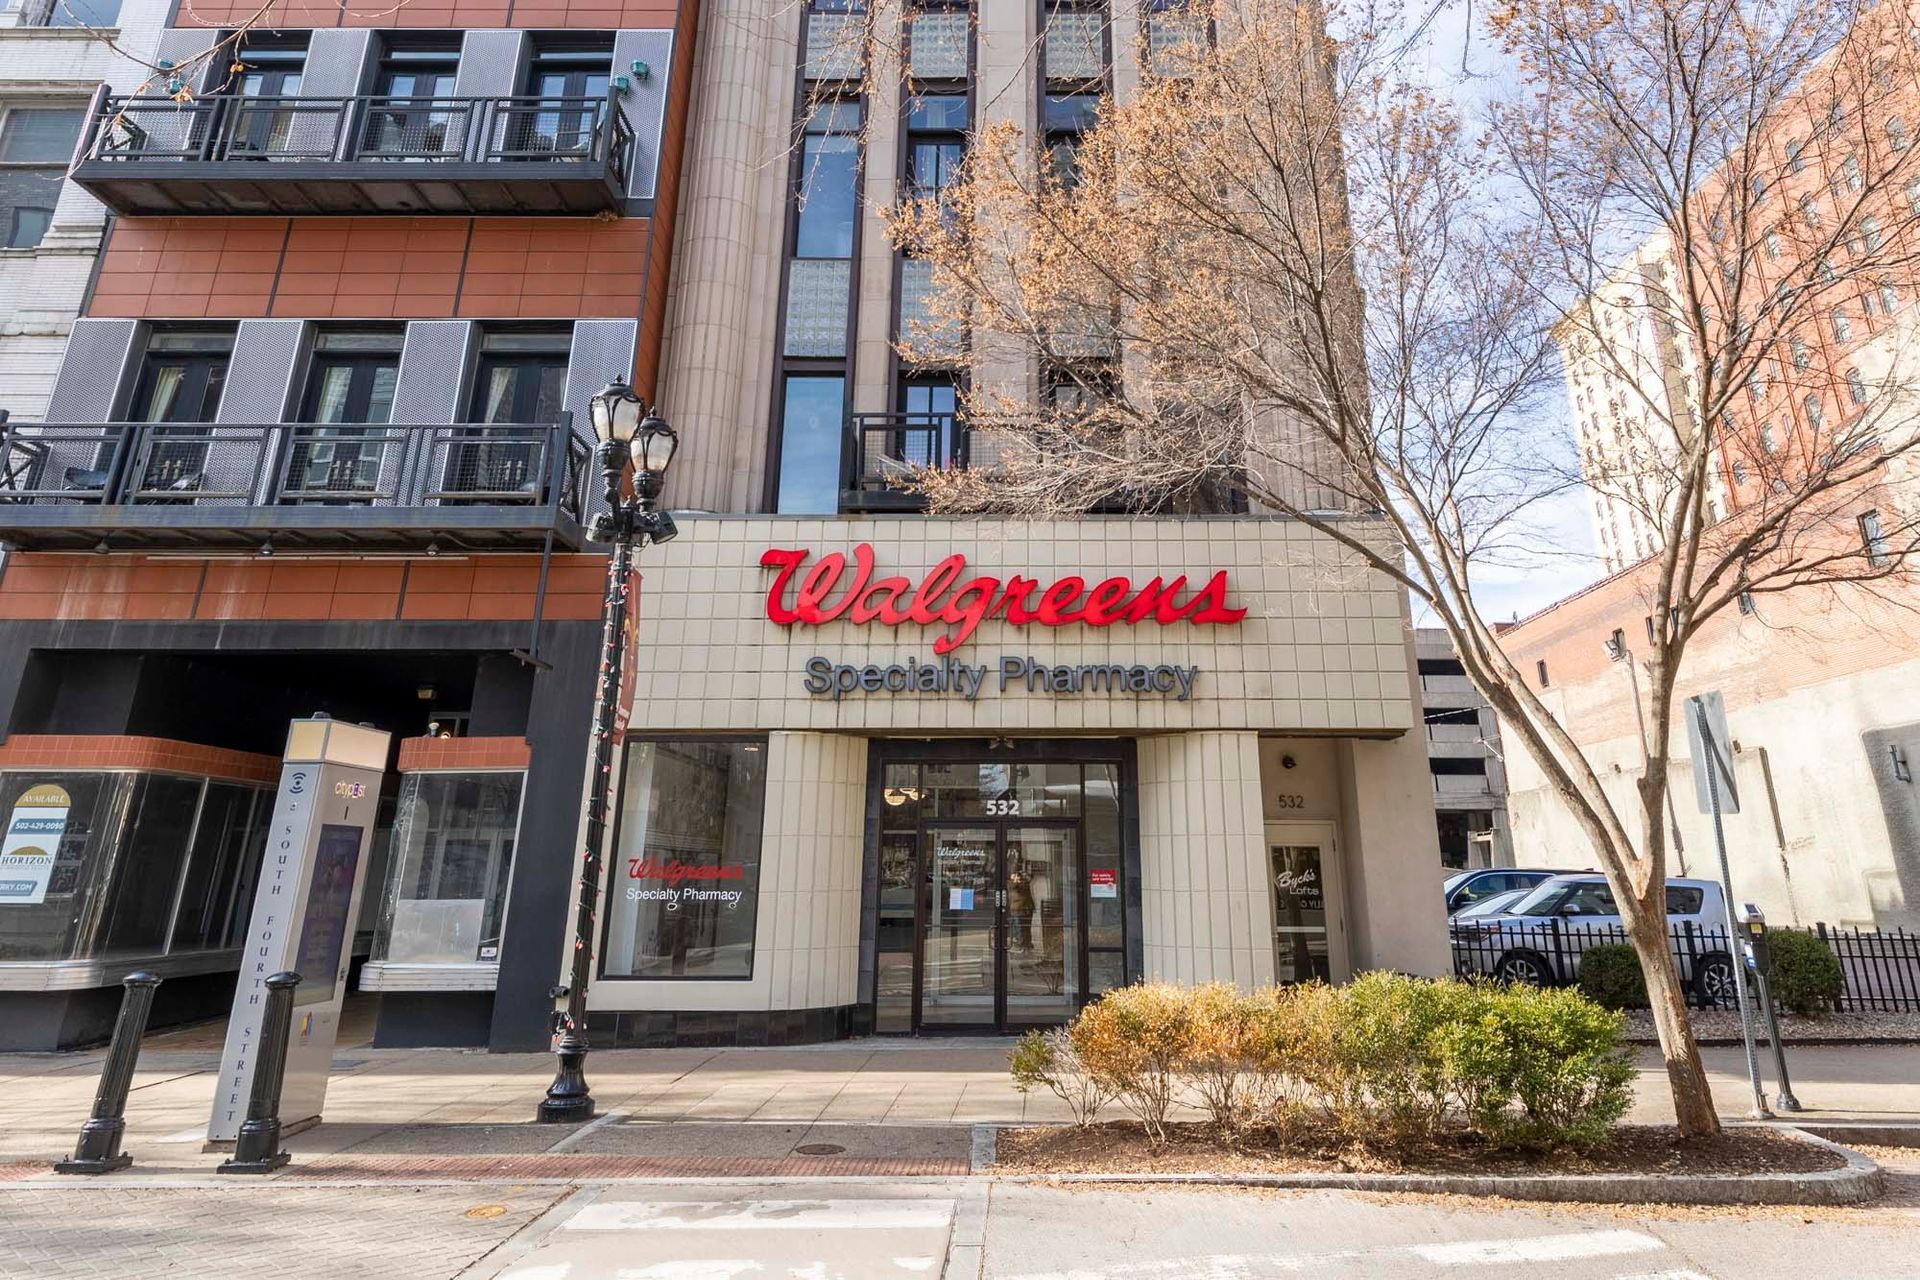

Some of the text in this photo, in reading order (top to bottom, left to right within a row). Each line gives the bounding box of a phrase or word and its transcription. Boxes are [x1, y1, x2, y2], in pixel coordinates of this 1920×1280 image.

[759, 542, 1248, 655] Walgreens
[803, 656, 1199, 700] Specialty Pharmacy
[23, 794, 65, 803] AVAILABLE
[1278, 794, 1304, 809] 532
[986, 800, 1020, 815] 532
[1, 856, 52, 865] HORIZON
[936, 847, 987, 860] Walgreens
[628, 855, 743, 888] Walgreens
[1277, 868, 1316, 889] Byck's
[626, 888, 743, 903] Specialty Pharmacy
[1289, 886, 1320, 895] Lofts
[226, 825, 292, 1121] SOUTH FOURTH STREET
